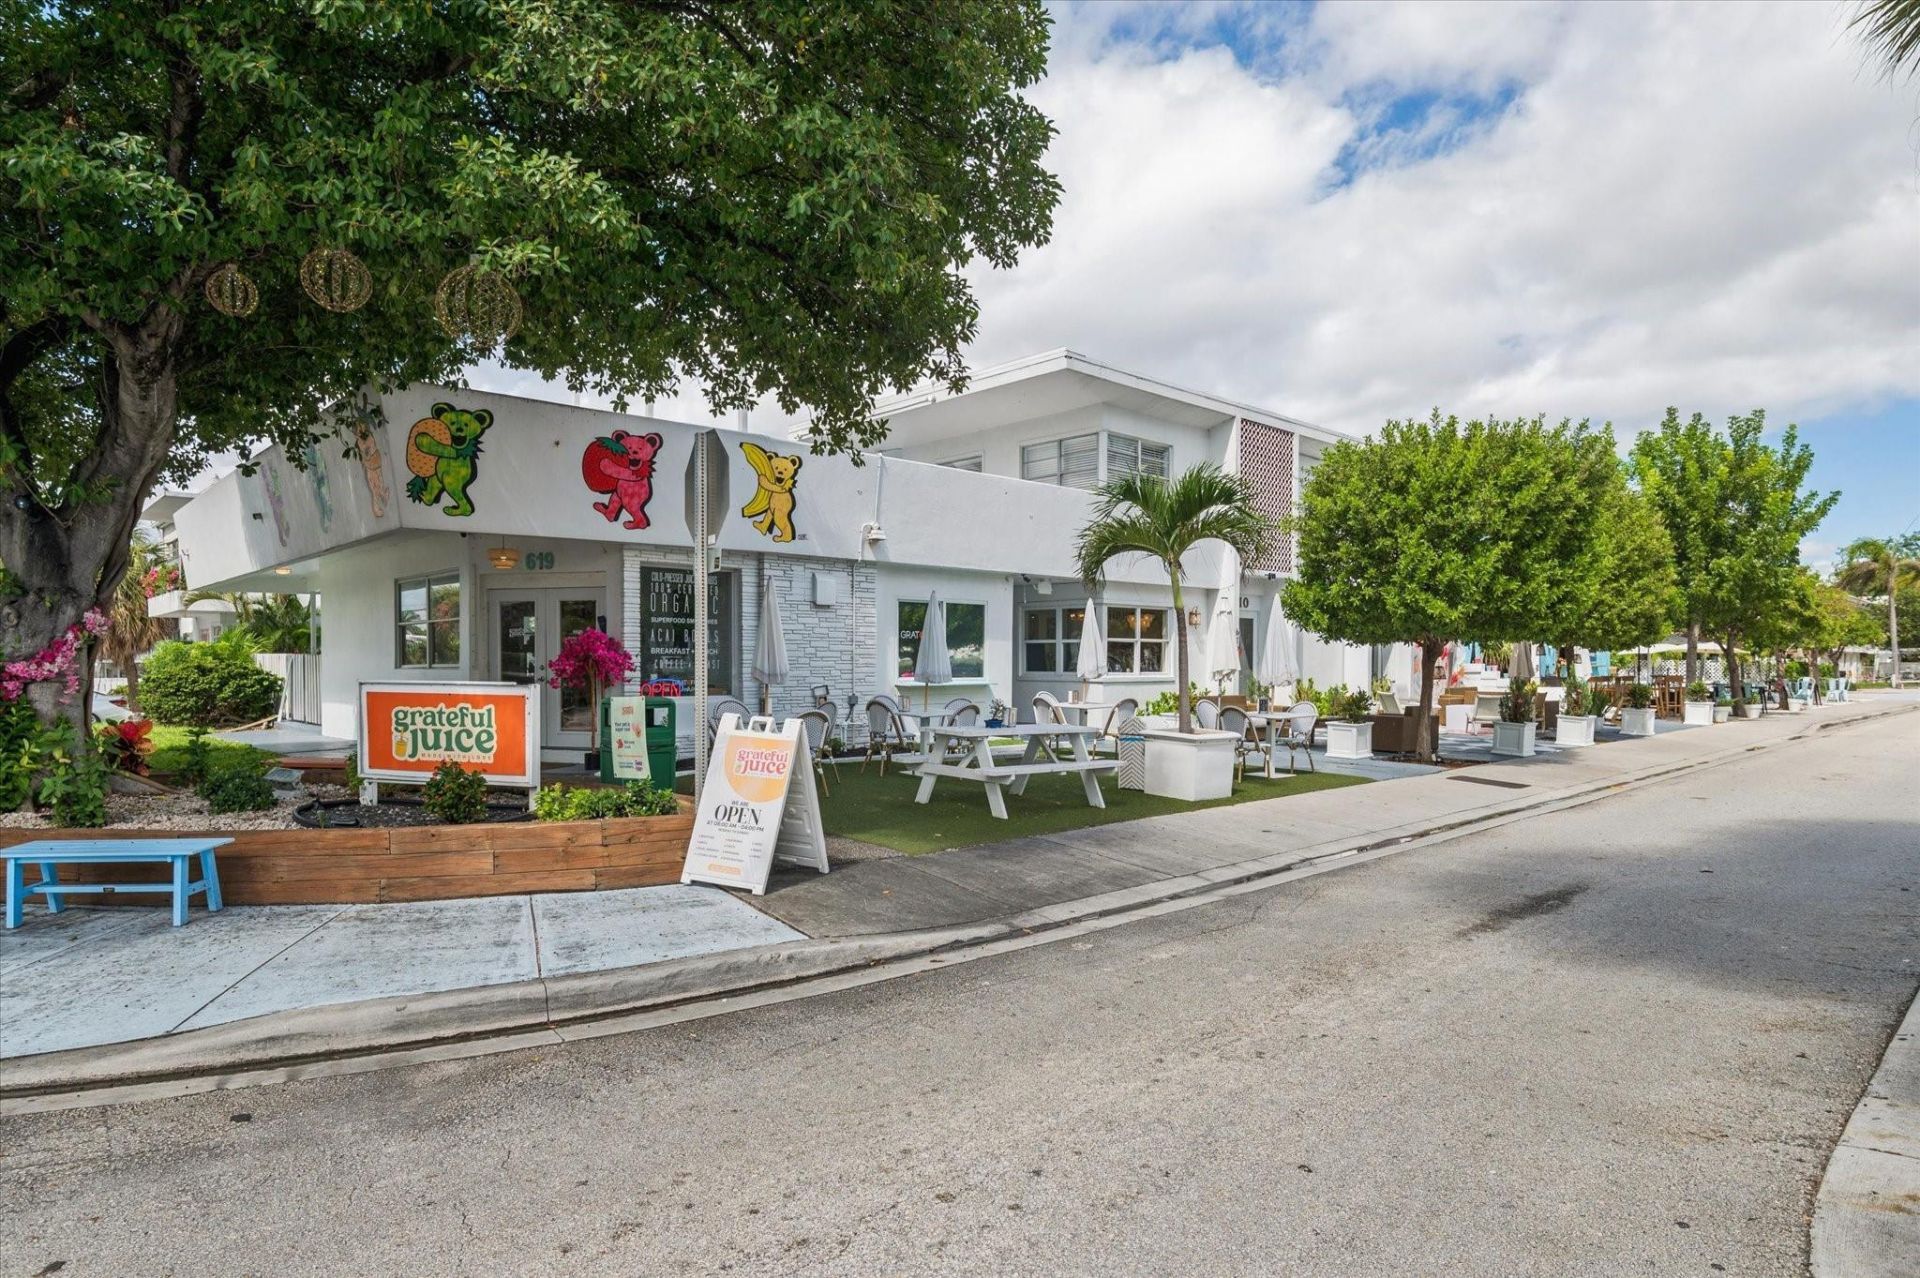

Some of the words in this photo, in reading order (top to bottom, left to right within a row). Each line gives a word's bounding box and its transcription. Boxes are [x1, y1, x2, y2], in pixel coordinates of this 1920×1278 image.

[525, 552, 554, 570] 619
[650, 583, 671, 593] 100%
[650, 592, 718, 614] ORGAC
[650, 628, 675, 642] ACAI
[650, 647, 690, 655] BREAKFAST
[641, 683, 681, 697] OPEN
[394, 707, 493, 732] grateful
[409, 728, 494, 759] juice
[737, 749, 788, 762] grateful
[741, 760, 787, 775] juice
[715, 804, 762, 826] OPEN
